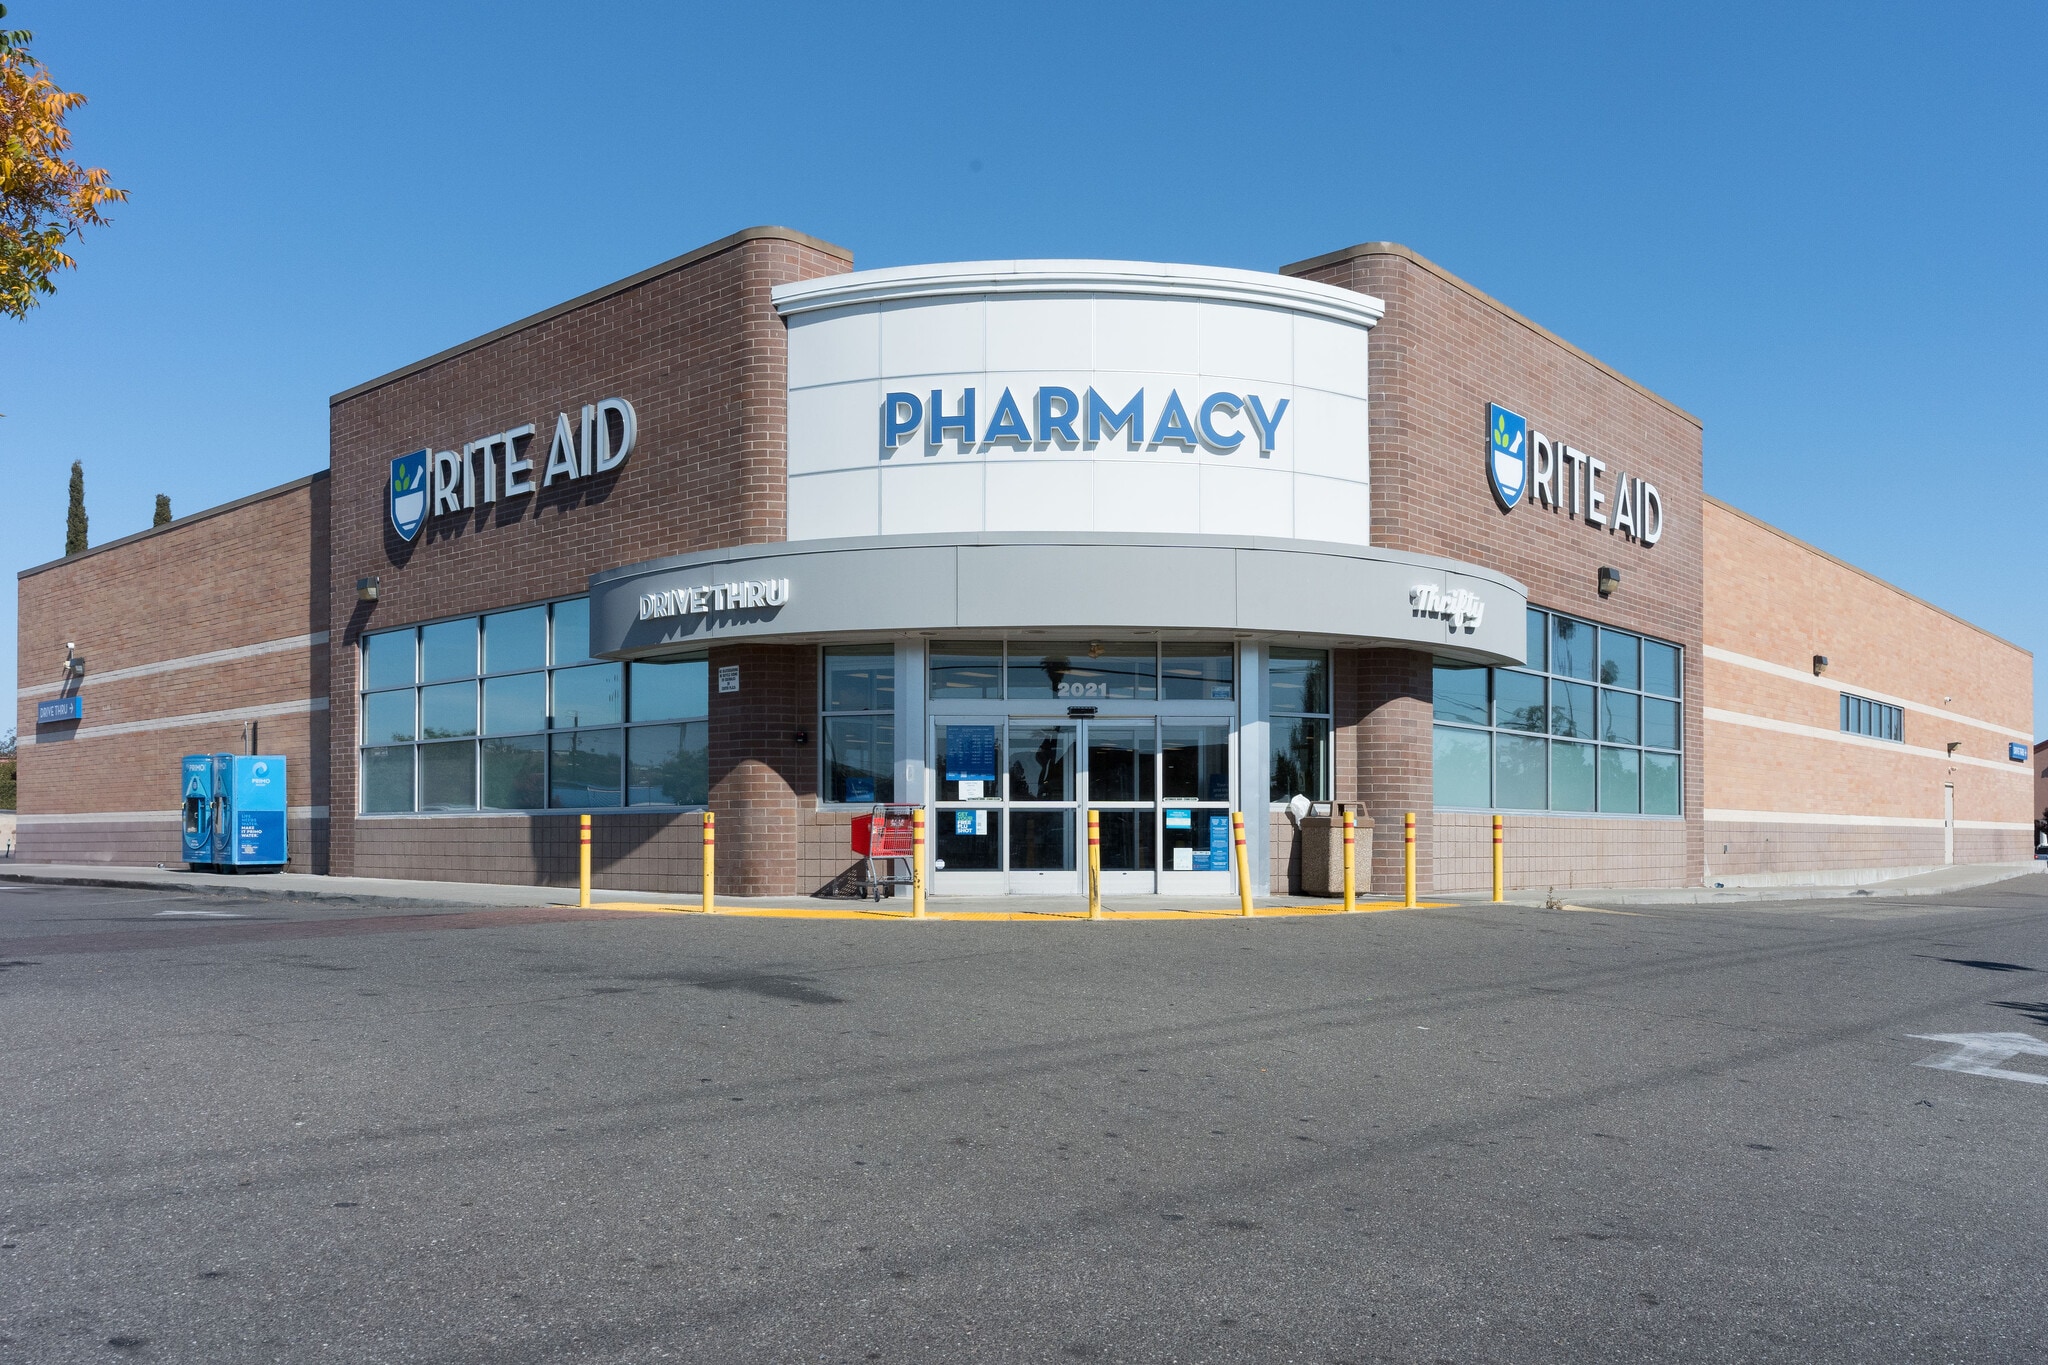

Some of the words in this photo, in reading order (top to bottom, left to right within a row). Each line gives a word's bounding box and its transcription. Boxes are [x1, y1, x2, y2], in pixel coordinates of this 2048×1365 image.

[884, 384, 1290, 453] PHARMACY
[434, 423, 535, 516] RITE
[543, 396, 637, 487] AID
[1529, 430, 1607, 525] RITE
[1611, 472, 1663, 544] AID
[639, 585, 708, 620] DRIVE
[709, 578, 789, 611] THRU
[40, 706, 55, 718] DRIVE
[55, 703, 68, 716] THRU
[1058, 682, 1107, 697] 2021
